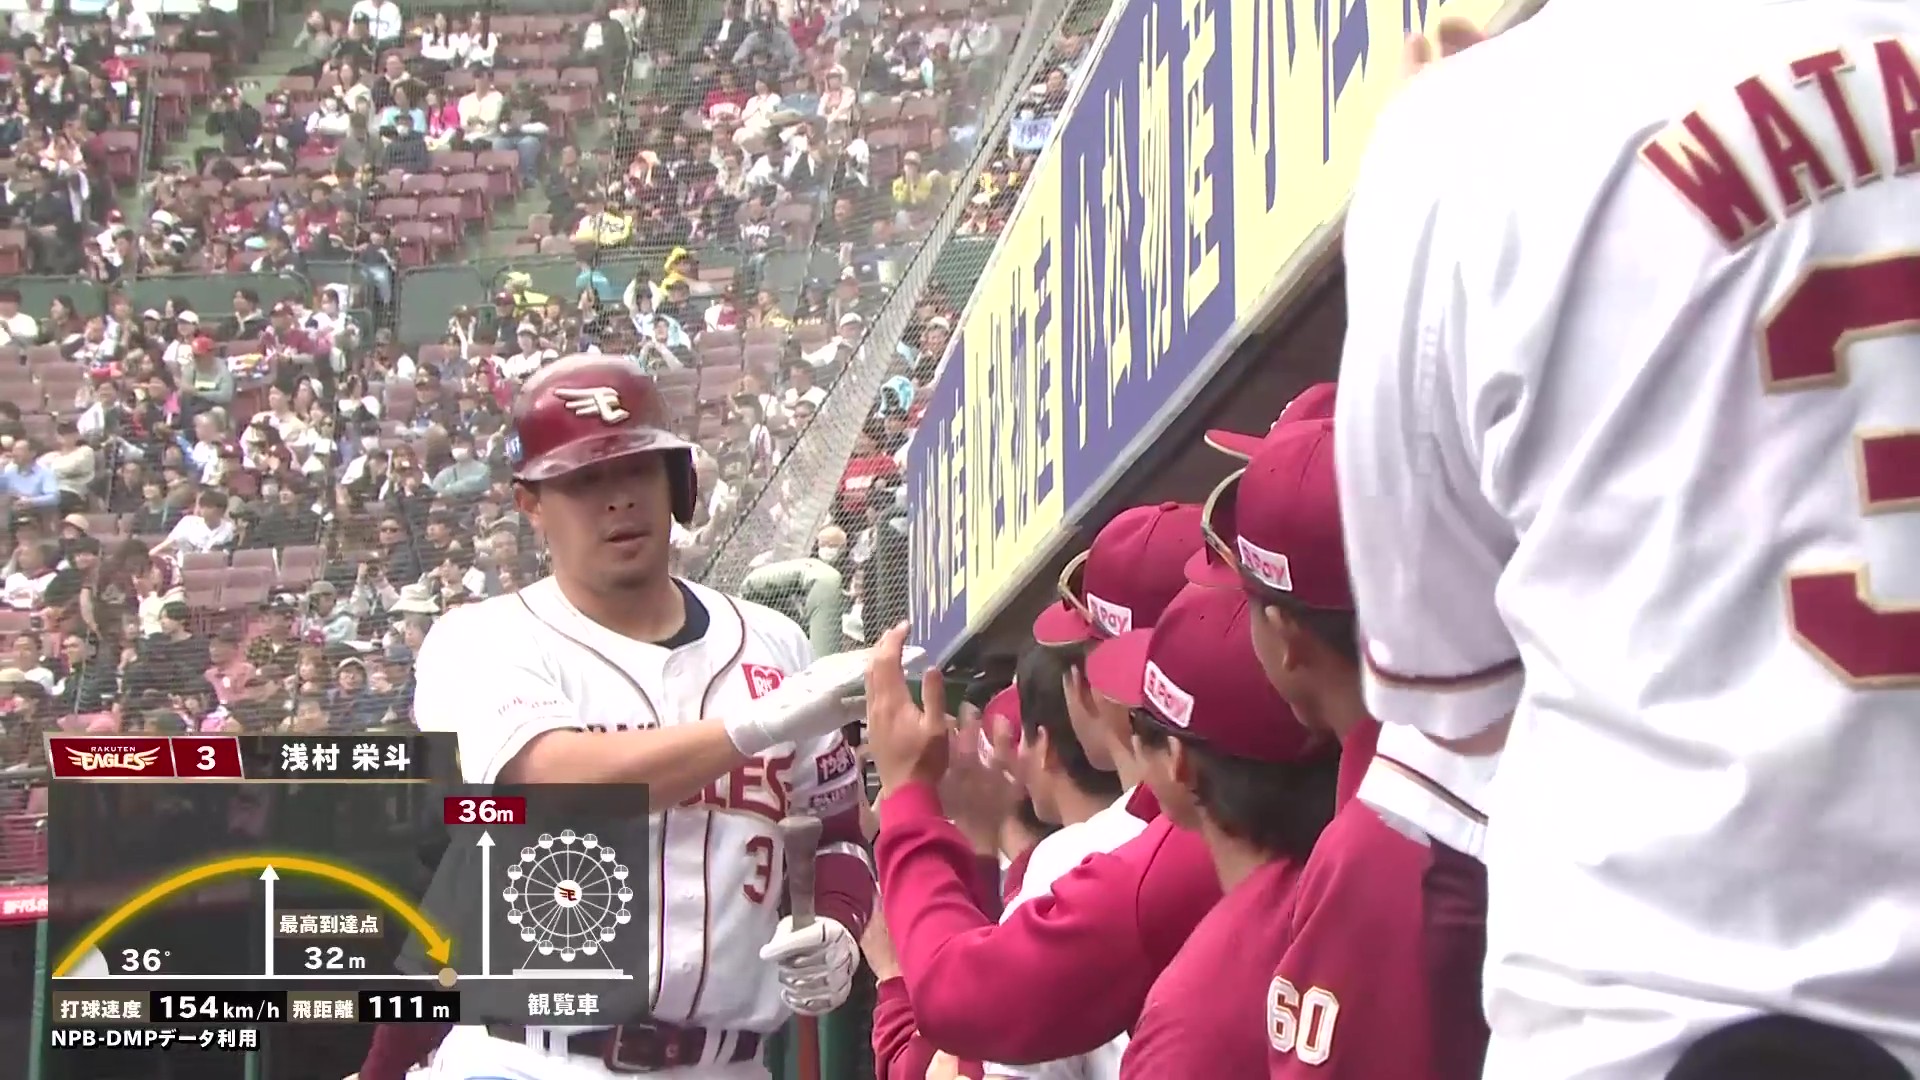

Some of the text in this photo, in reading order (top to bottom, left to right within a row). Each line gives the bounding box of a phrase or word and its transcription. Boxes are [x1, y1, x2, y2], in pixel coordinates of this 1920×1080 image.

[1070, 0, 1220, 450] 小松物産
[743, 834, 774, 905] 3
[1266, 976, 1340, 1066] 60
